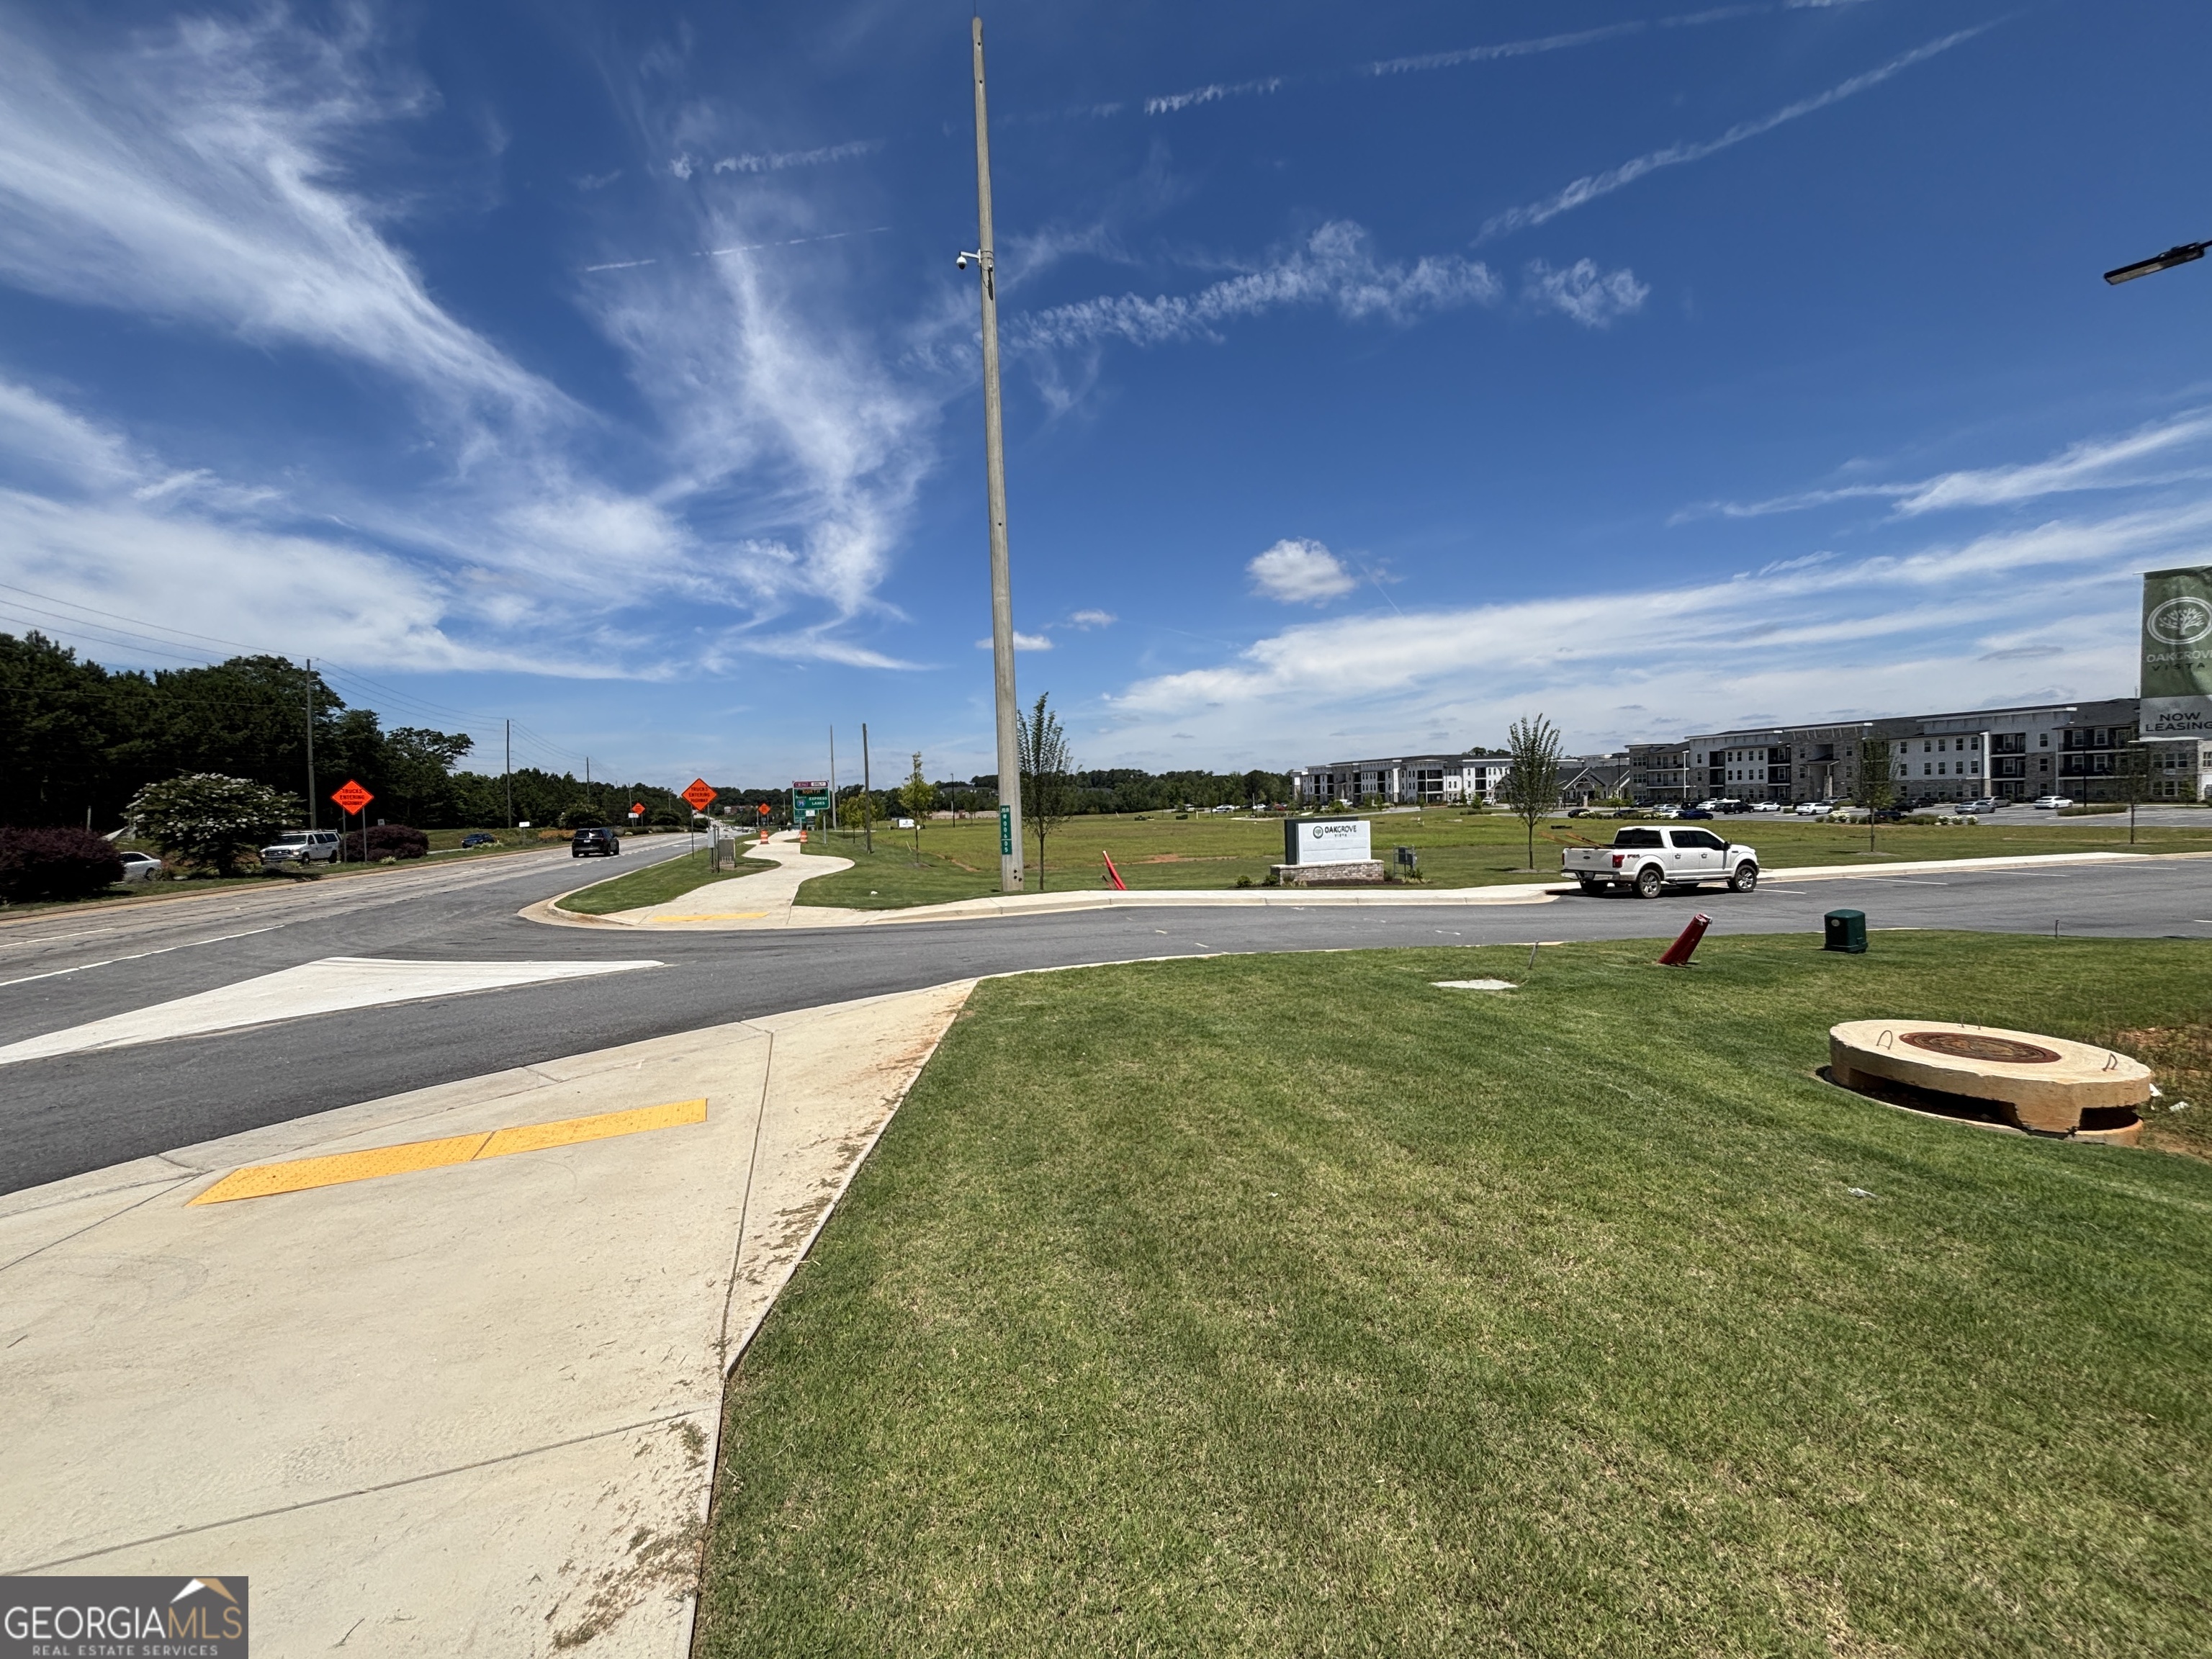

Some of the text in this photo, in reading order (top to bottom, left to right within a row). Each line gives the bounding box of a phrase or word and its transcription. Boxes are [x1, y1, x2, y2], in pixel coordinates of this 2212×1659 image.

[2152, 662, 2205, 671] VISTA
[2159, 712, 2200, 721] NOW
[2146, 721, 2212, 732] LEASING
